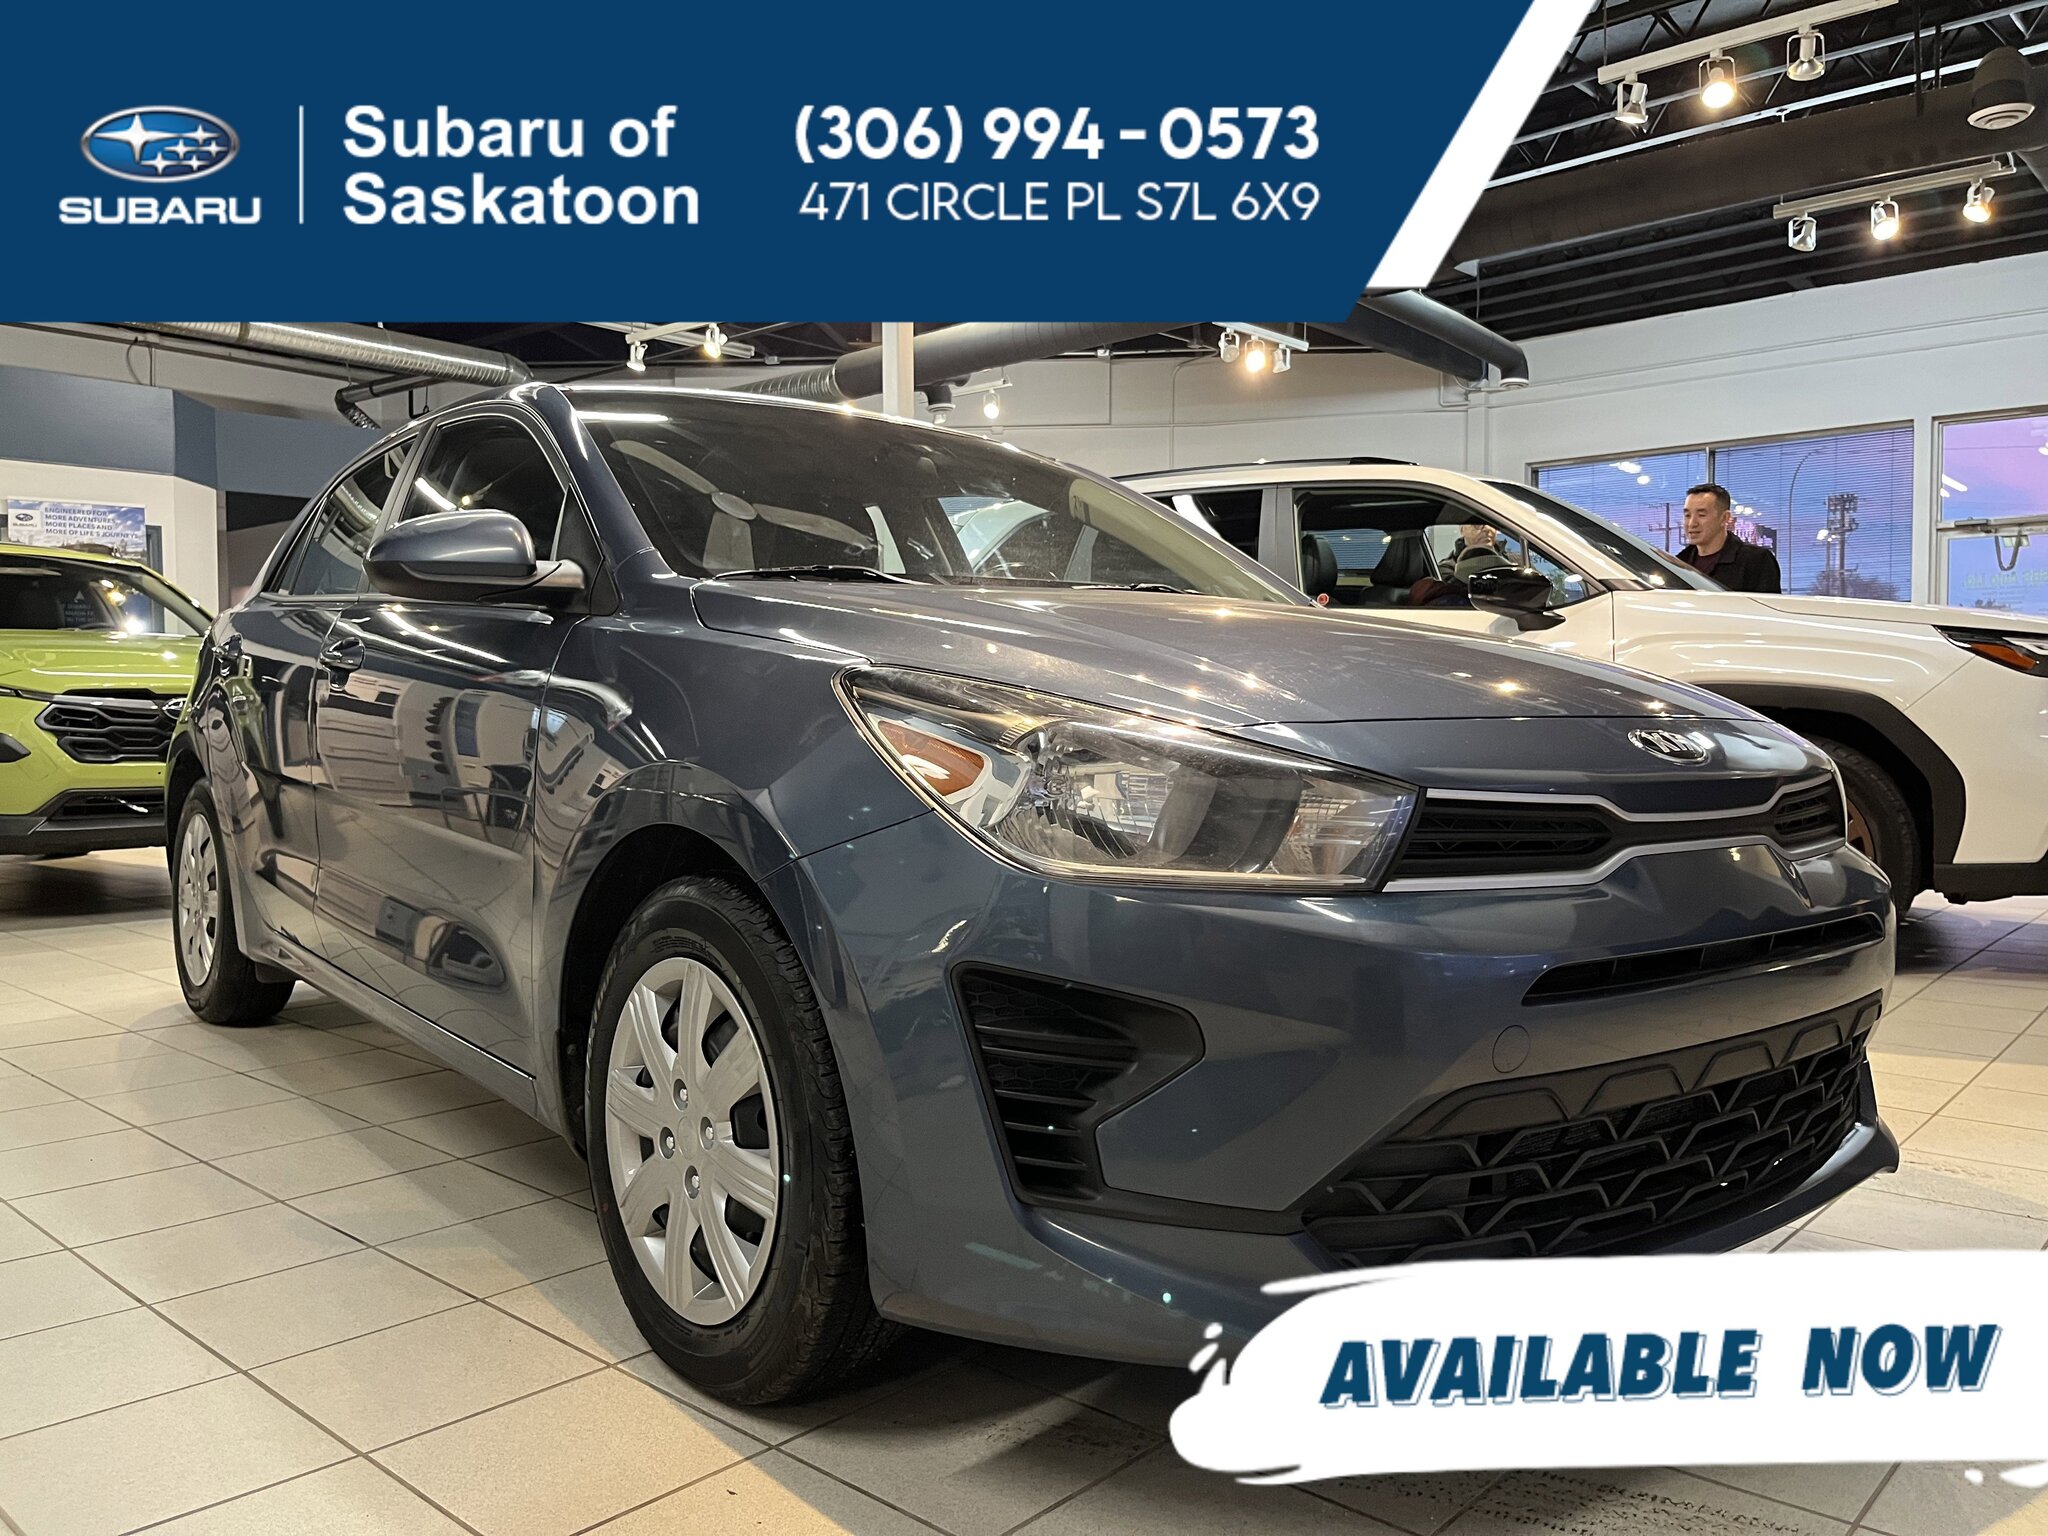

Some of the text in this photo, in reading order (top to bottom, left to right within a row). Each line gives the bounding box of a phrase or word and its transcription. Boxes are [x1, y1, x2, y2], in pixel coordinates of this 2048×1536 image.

[45, 514, 66, 522] MORE
[45, 521, 67, 529] MORE
[45, 528, 67, 536] MORE
